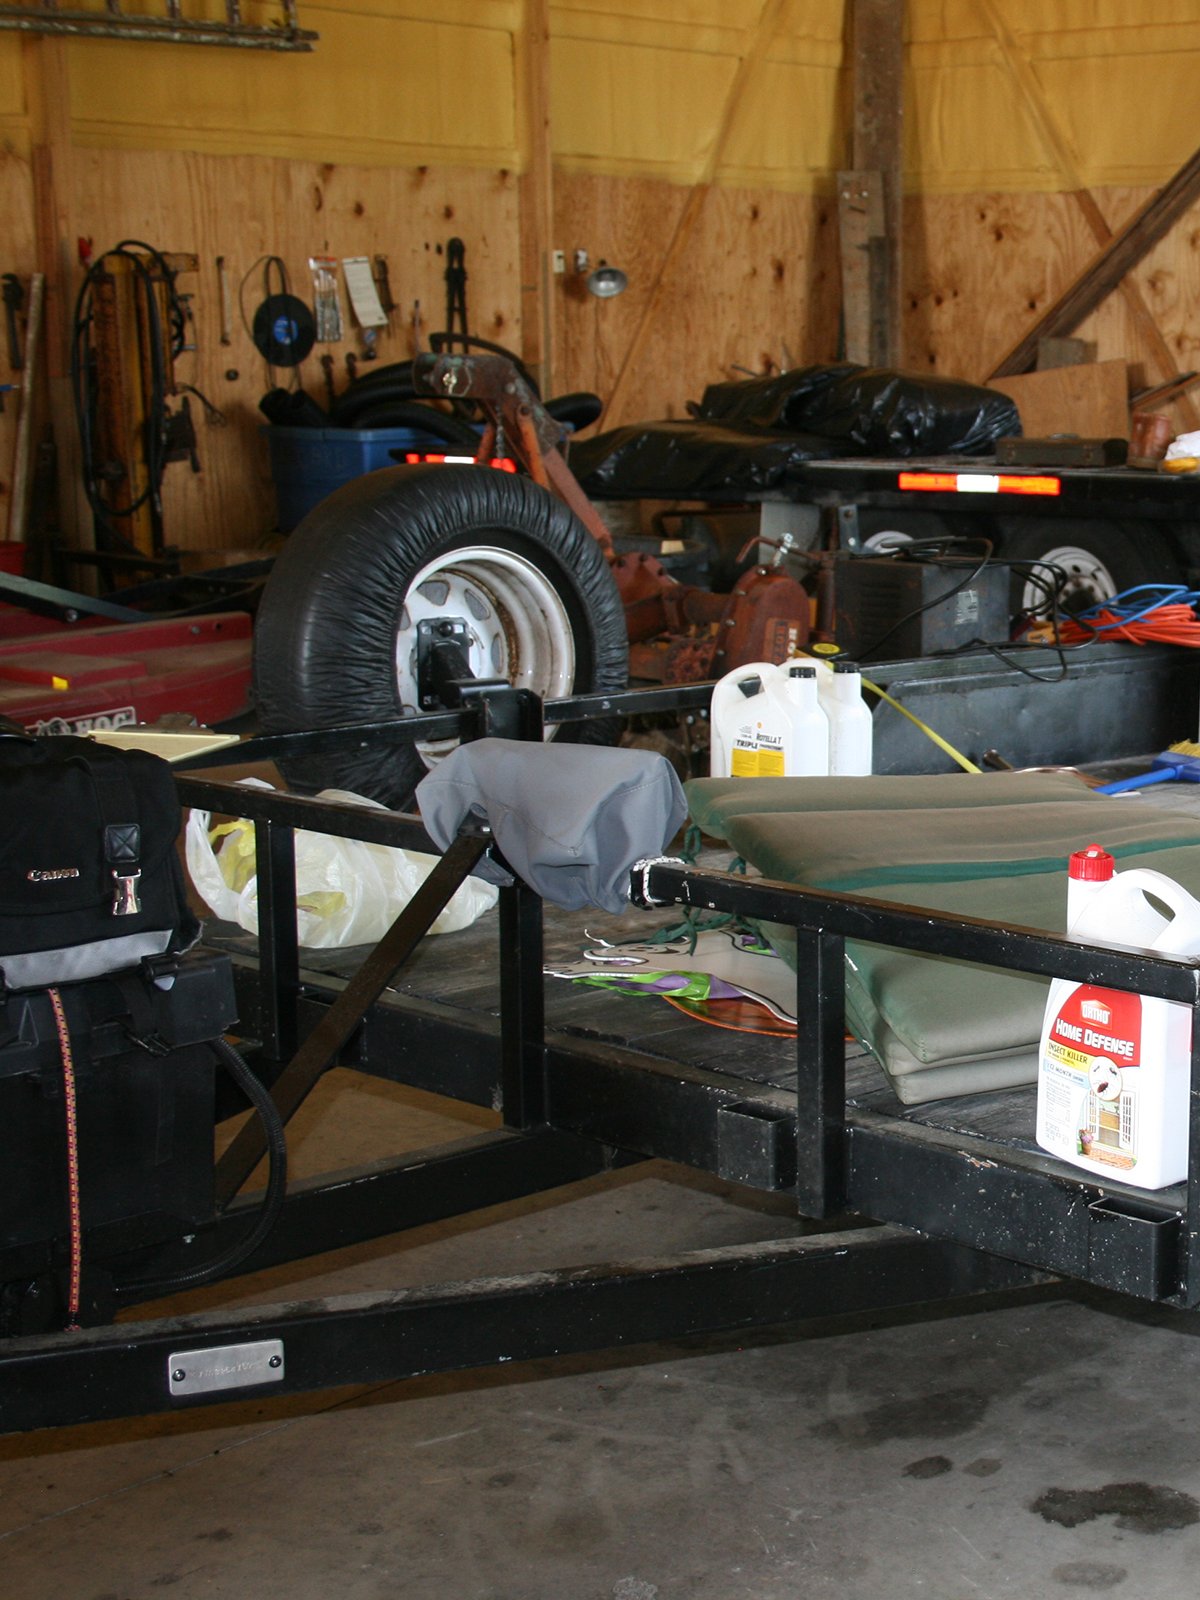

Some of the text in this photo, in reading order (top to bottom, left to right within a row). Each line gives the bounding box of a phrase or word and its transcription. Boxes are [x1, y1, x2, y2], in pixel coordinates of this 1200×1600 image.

[756, 733, 777, 744] ROTELLA
[27, 868, 80, 882] Canon
[1082, 1005, 1110, 1025] ORTHO
[1055, 1018, 1135, 1057] HOME DEFENSE
[1048, 1041, 1066, 1056] INSECT
[1067, 1050, 1088, 1064] KILLER
